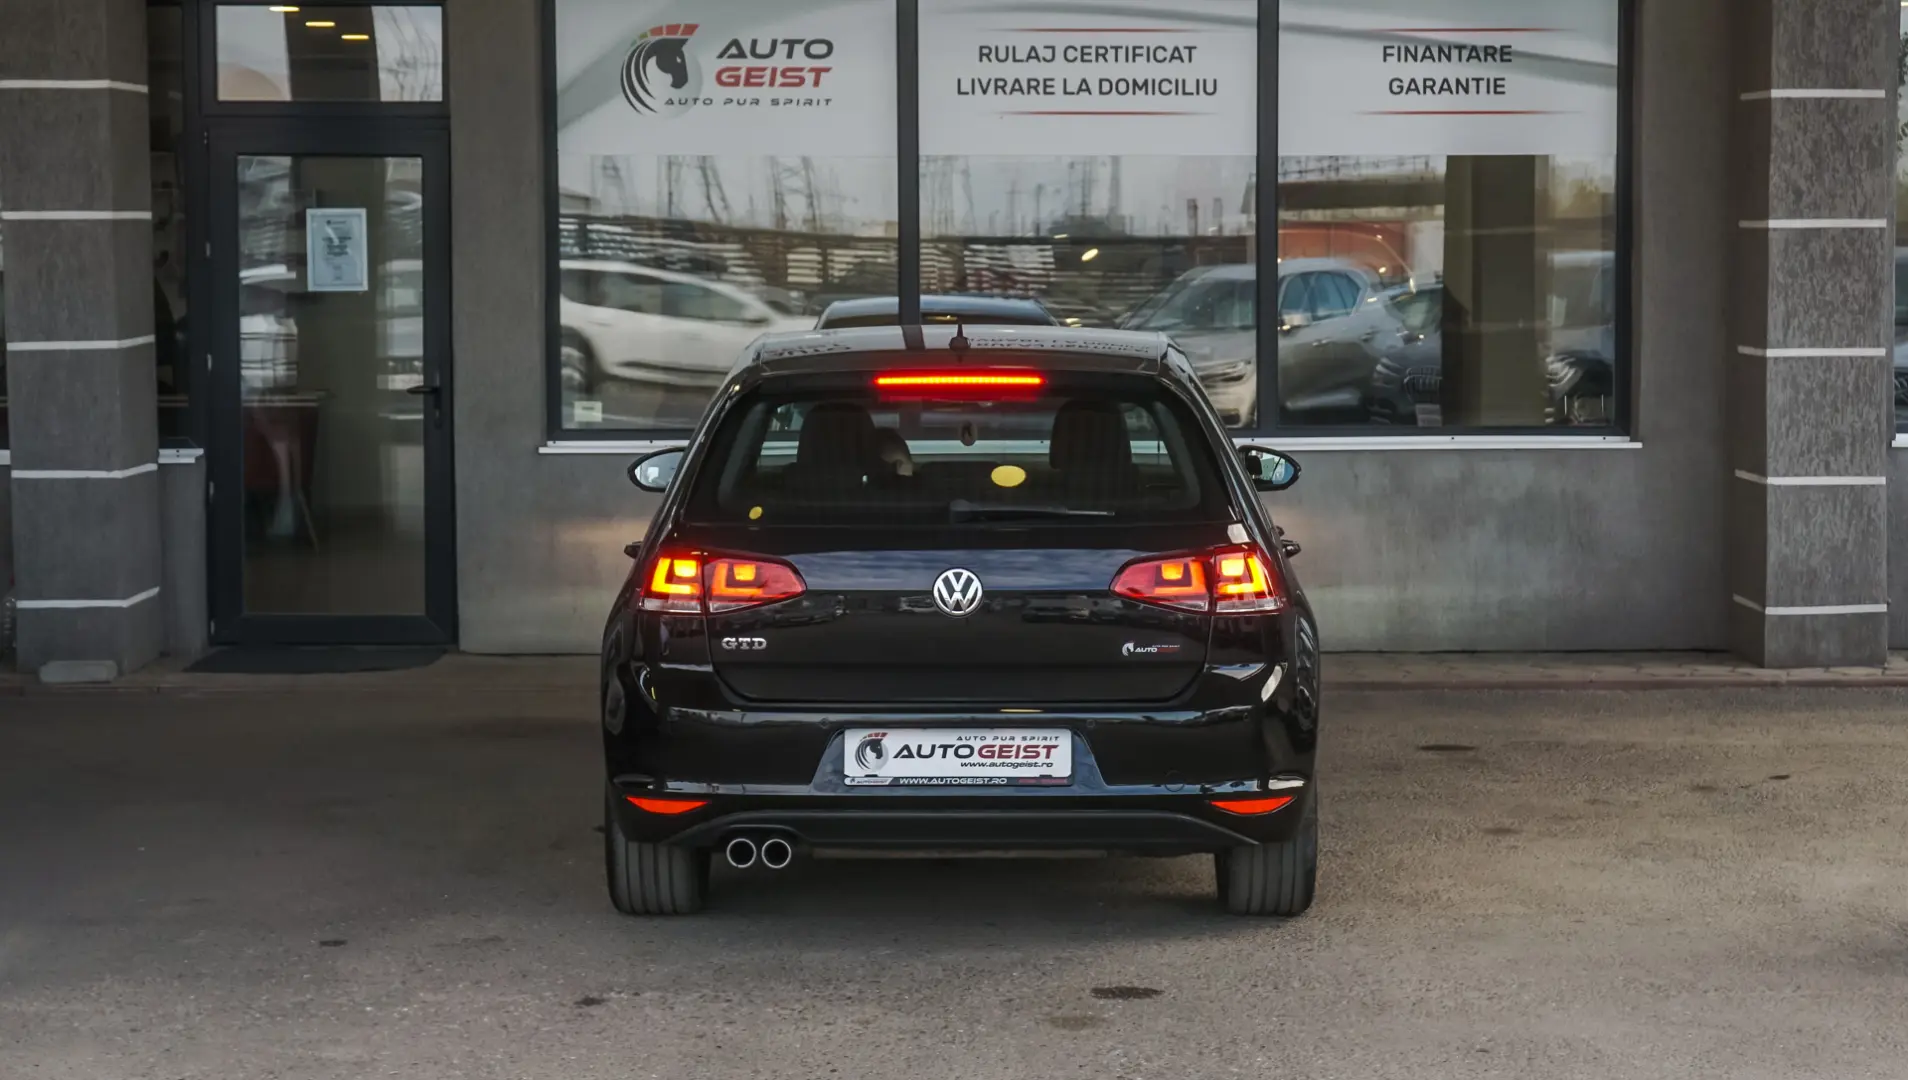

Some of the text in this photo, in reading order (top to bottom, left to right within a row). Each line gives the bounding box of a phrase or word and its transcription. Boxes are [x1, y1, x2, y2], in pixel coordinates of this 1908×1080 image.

[716, 38, 834, 59] AUTO
[978, 45, 1197, 63] RULAJ CERTIFICAT
[1383, 45, 1513, 63] FINANTARE
[715, 66, 833, 88] GEIST
[1388, 77, 1506, 95] GARANTIE
[957, 78, 1218, 96] LIVRARE LA DOMICILIU
[664, 97, 832, 106] AUTO PUR SPIRIT
[721, 637, 767, 650] GTD
[961, 761, 1053, 769] www.autogeist.ro
